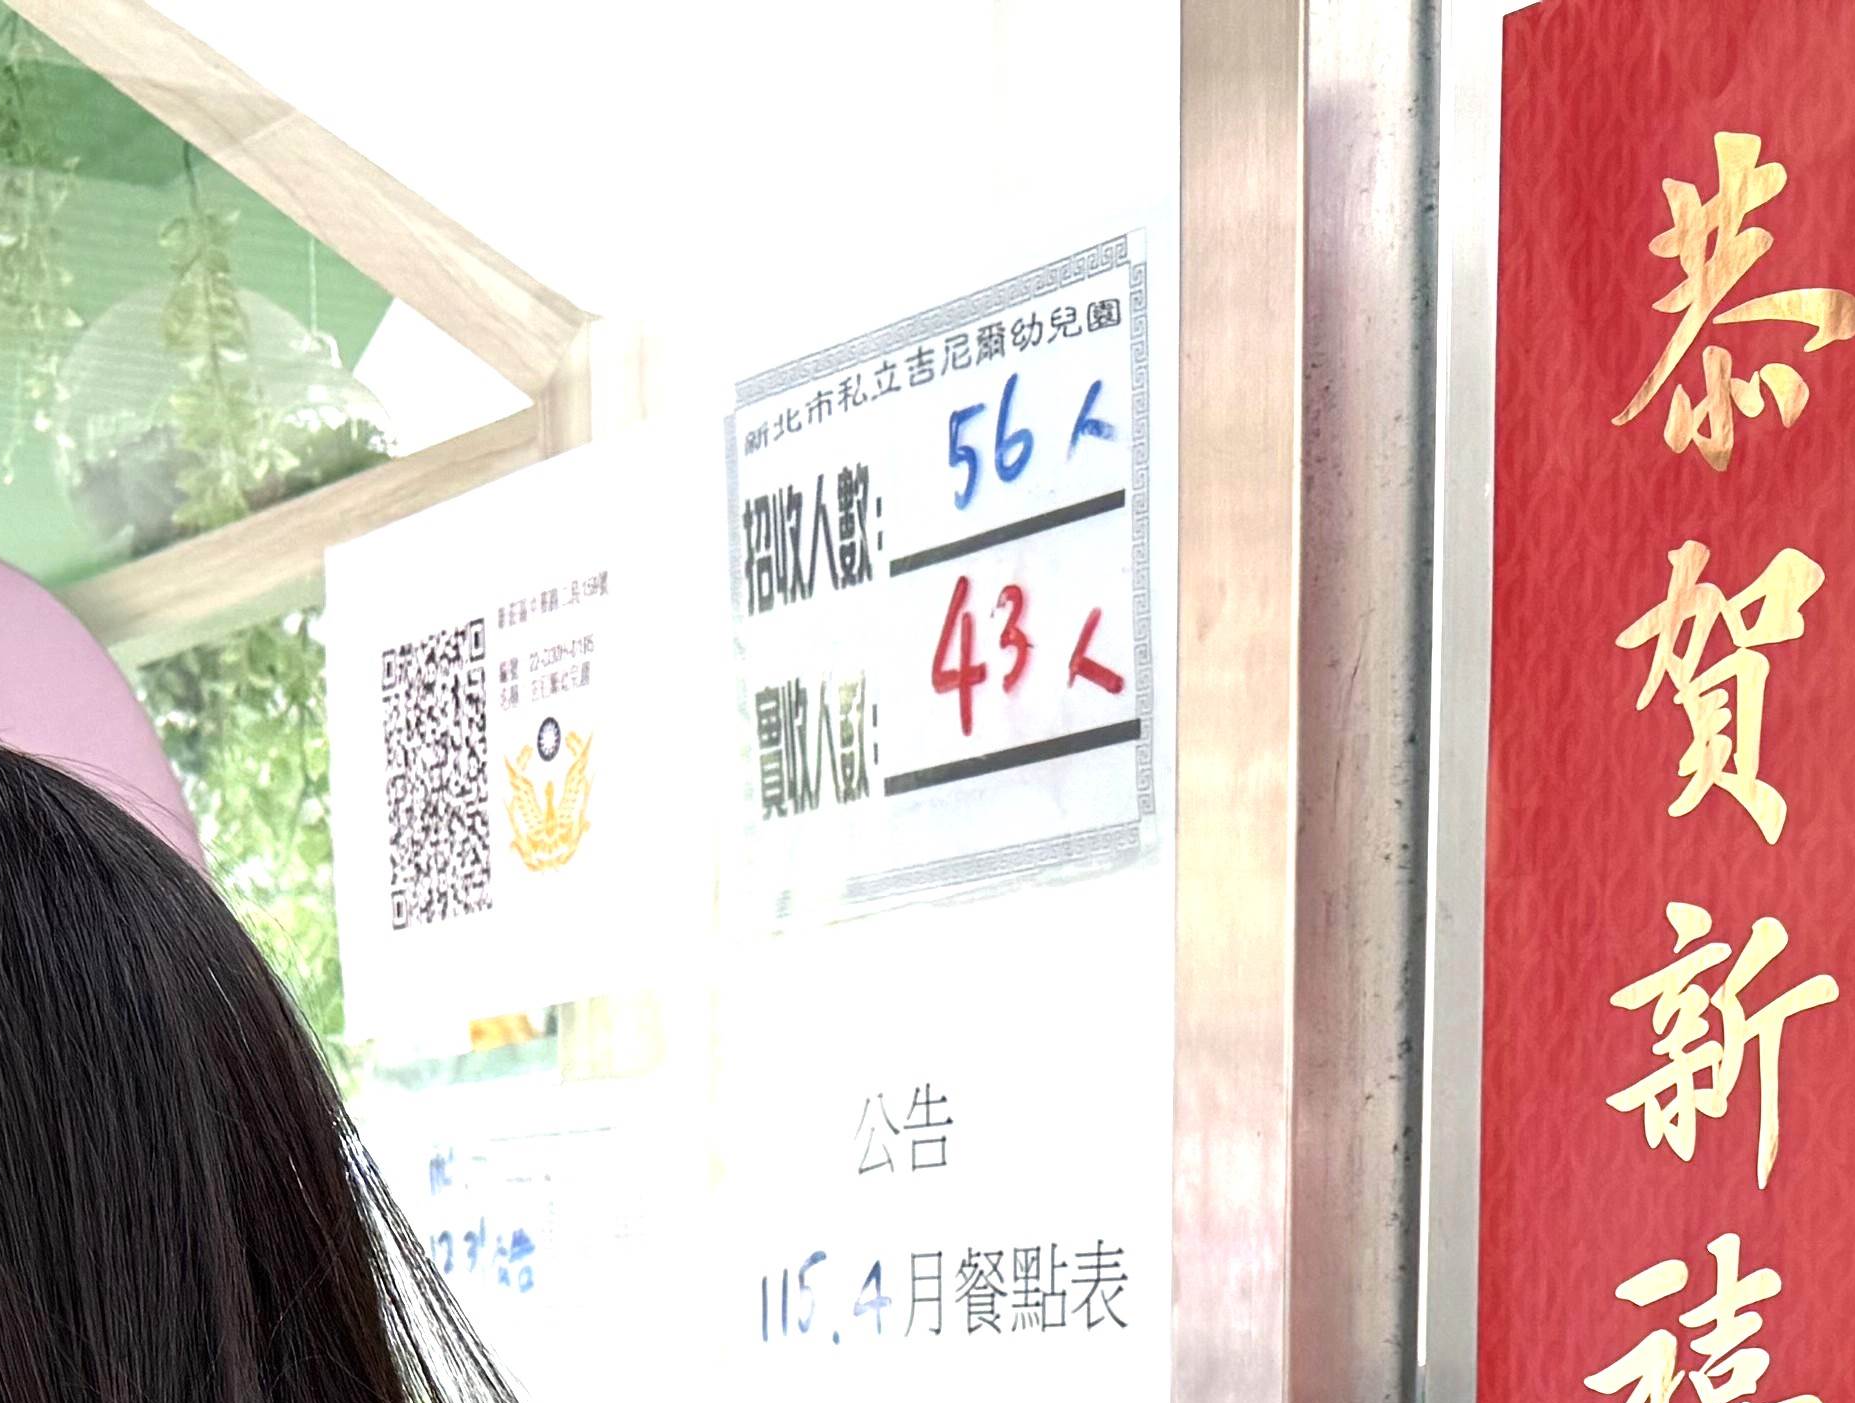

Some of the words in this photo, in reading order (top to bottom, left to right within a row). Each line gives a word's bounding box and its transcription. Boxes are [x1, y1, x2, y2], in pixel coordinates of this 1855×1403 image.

[744, 298, 1121, 457] 新北市私立吉尼爾幼兒園
[854, 1082, 954, 1175] 公告
